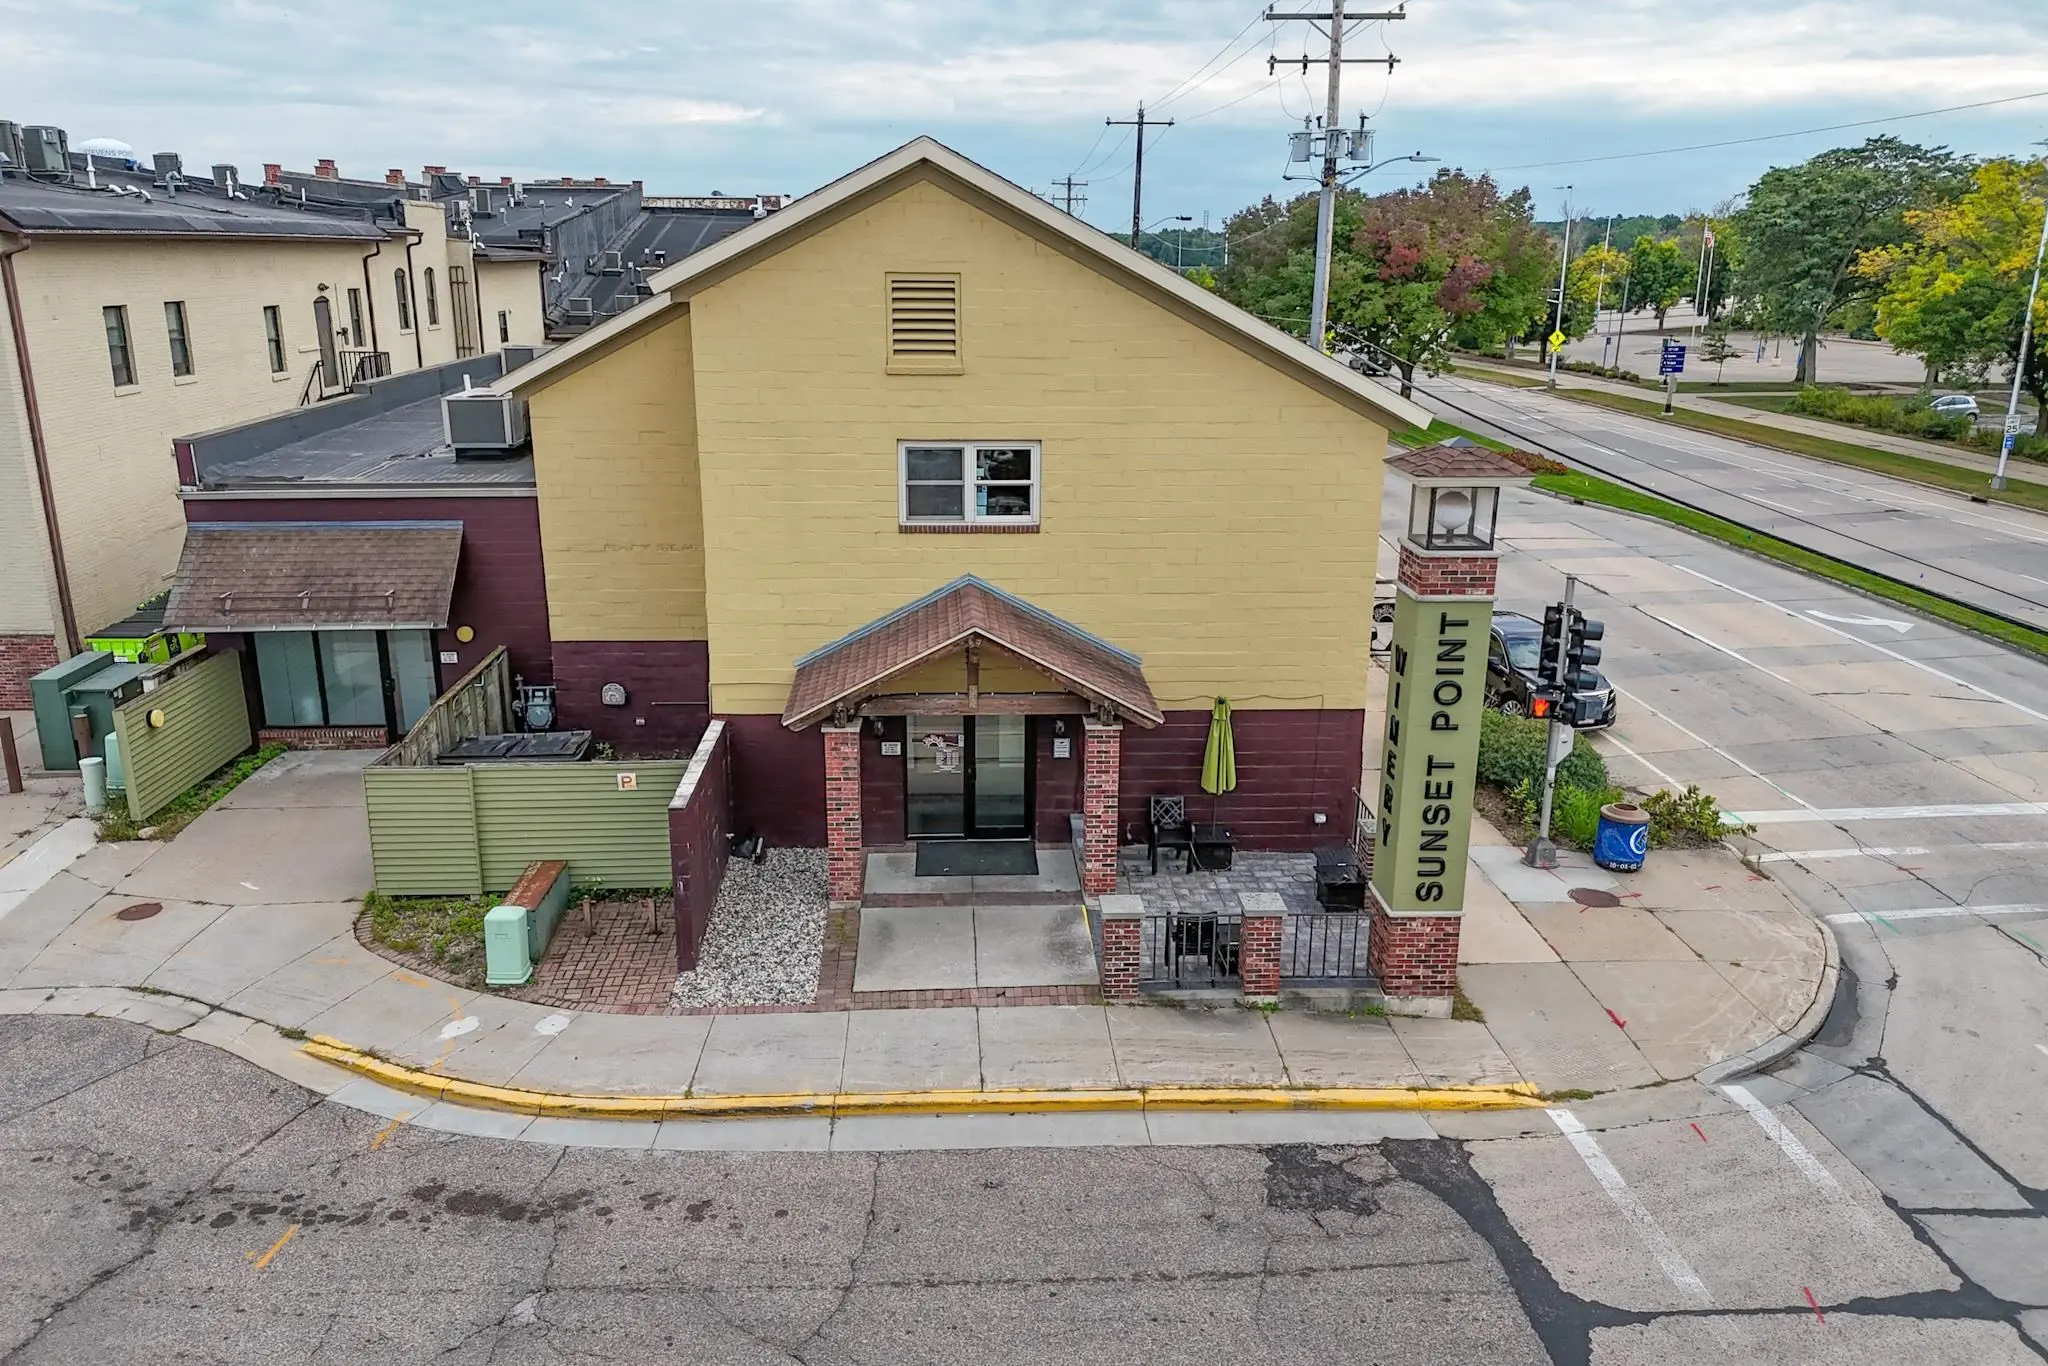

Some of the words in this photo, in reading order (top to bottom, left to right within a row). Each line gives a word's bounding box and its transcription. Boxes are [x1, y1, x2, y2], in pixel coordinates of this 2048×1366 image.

[1430, 612, 1469, 731] POINT
[1382, 644, 1407, 847] WINERY
[1415, 755, 1455, 902] SUNSET
